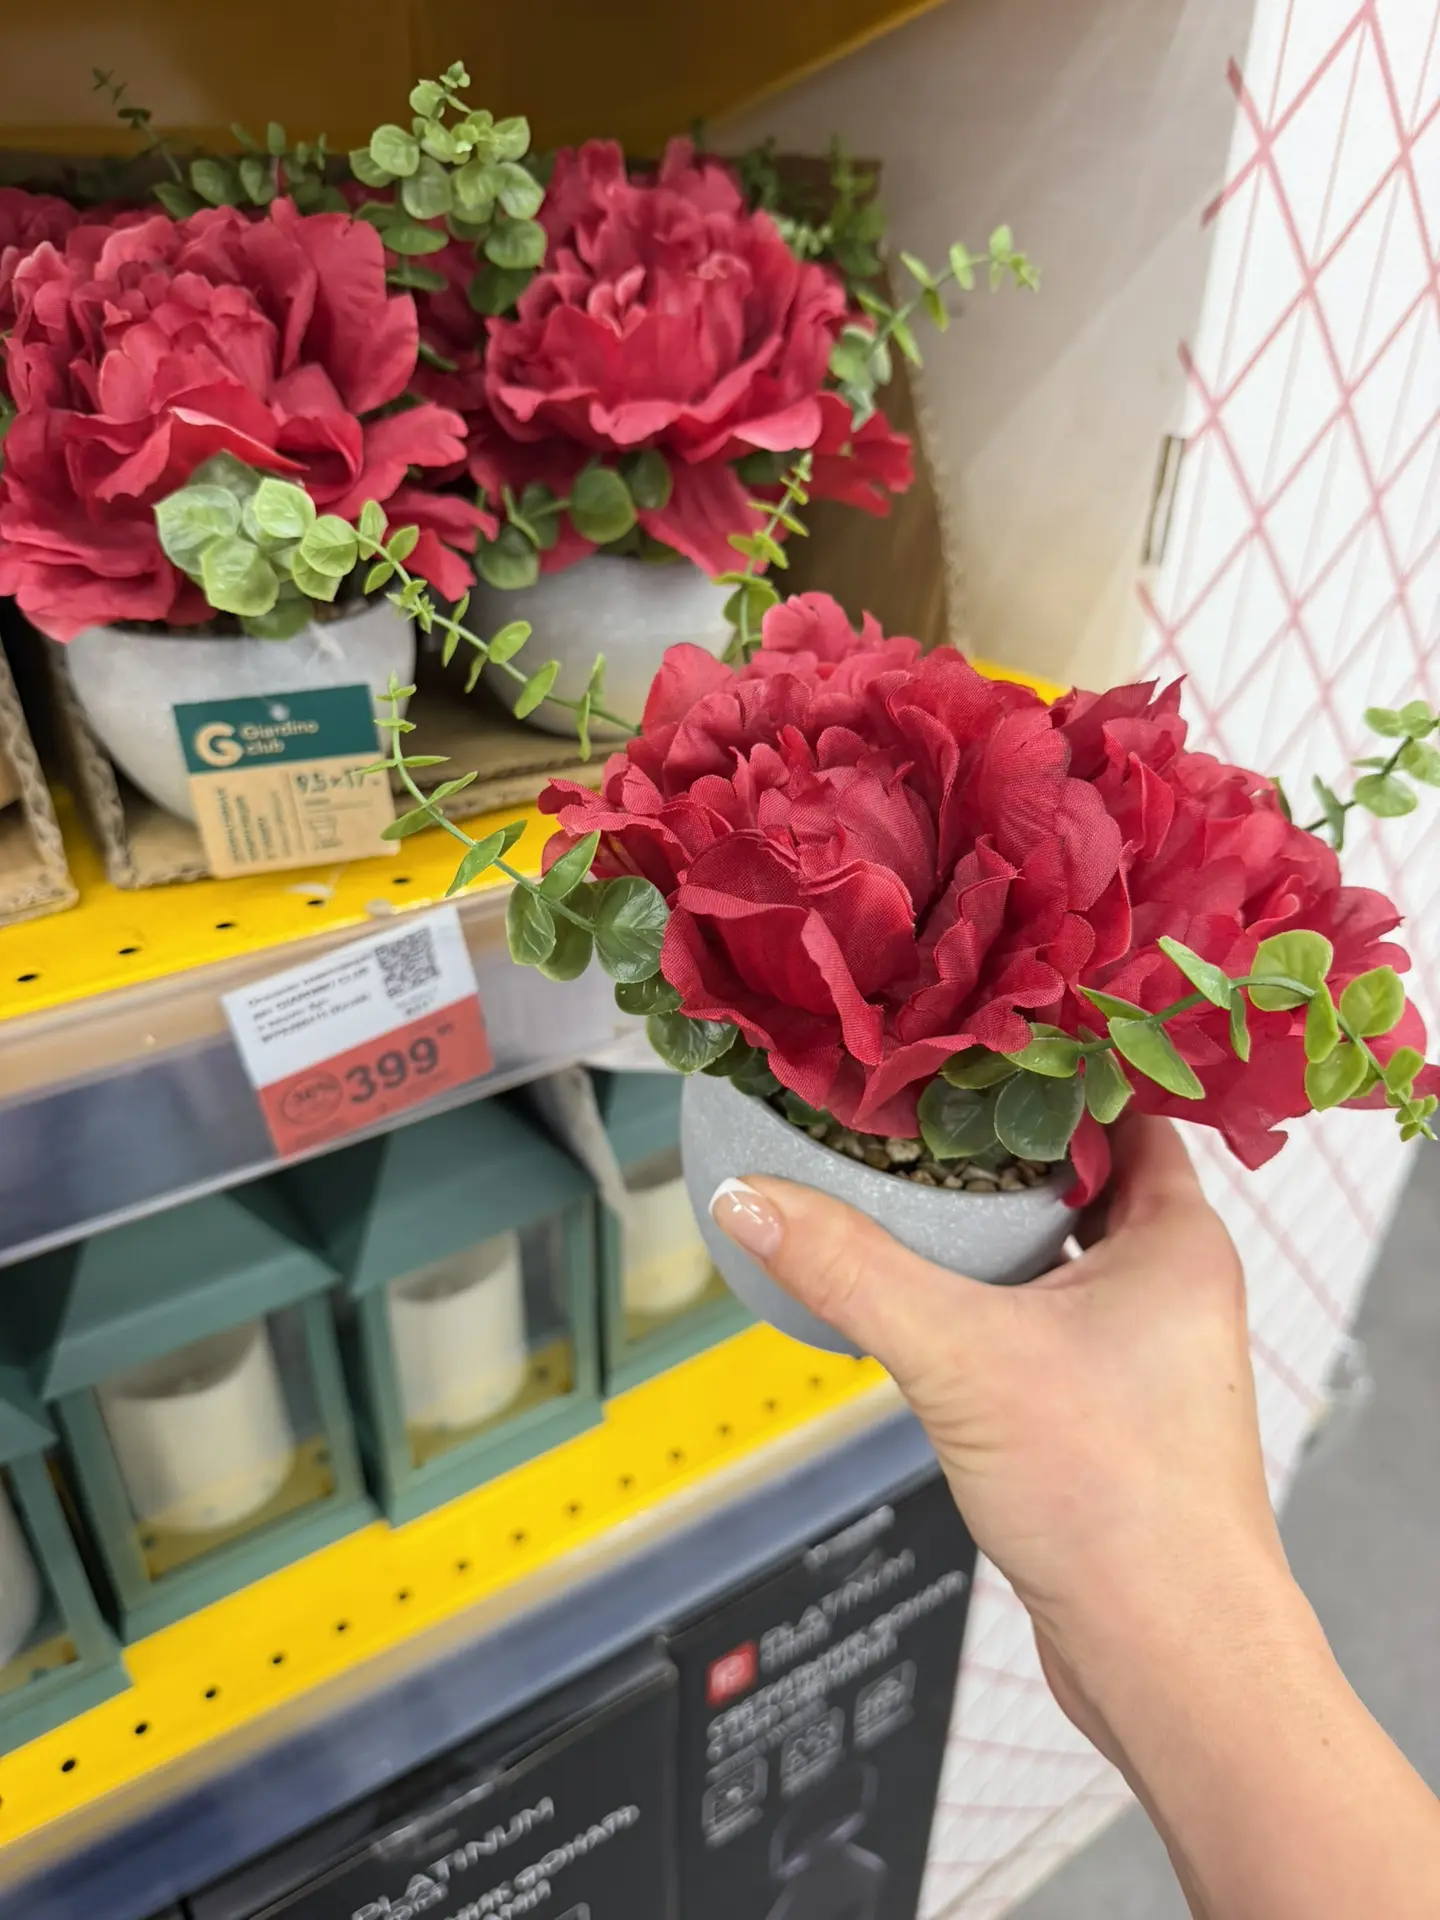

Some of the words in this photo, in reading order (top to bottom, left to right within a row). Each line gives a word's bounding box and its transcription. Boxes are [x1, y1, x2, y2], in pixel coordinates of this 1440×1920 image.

[195, 722, 243, 767] G
[241, 719, 320, 741] Giardino
[345, 1036, 438, 1104] 399
